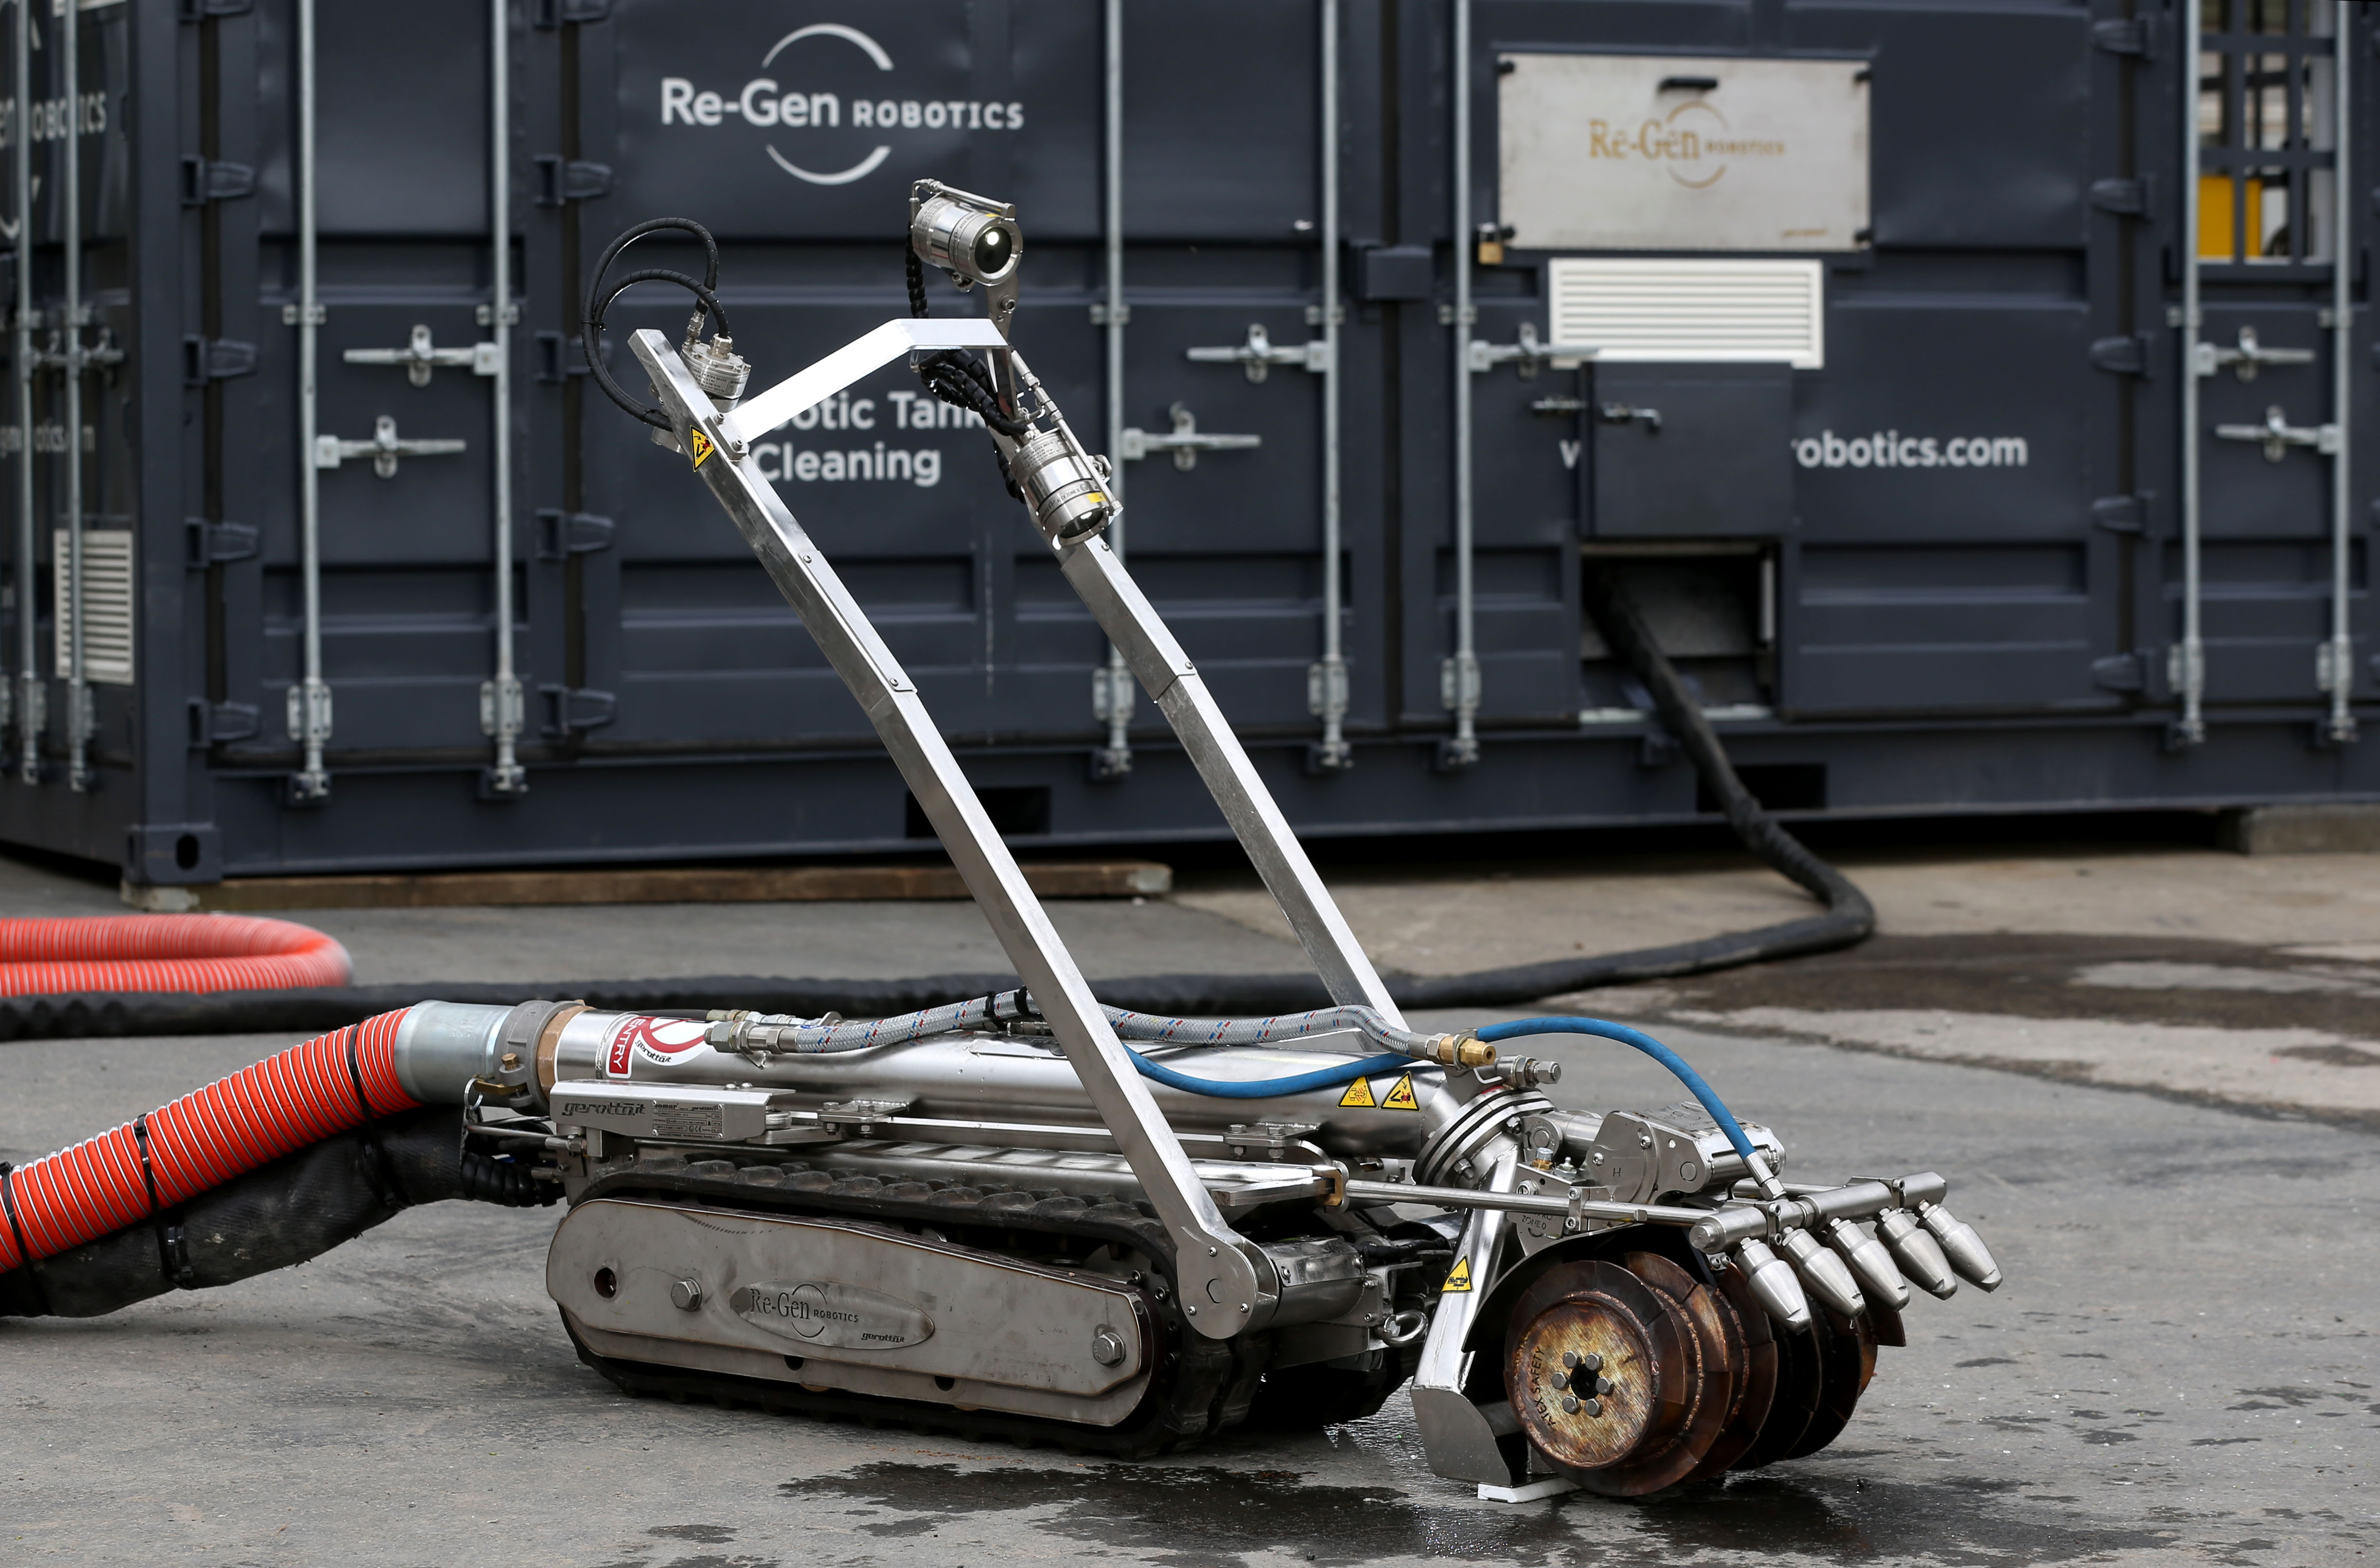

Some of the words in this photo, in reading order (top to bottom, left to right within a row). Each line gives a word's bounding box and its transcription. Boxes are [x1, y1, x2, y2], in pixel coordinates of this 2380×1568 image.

[662, 78, 839, 127] Re-Gen
[853, 99, 1024, 130] ROBOTICS
[1589, 119, 1700, 160] Re-Gen
[772, 391, 876, 431] otic
[752, 441, 941, 487] Cleaning
[1790, 428, 2028, 468] obotics.com
[613, 1018, 646, 1069] ENTRY
[1521, 1215, 1541, 1228] ZONE
[751, 1288, 810, 1319] Re-Gen
[814, 1309, 859, 1323] ROBOTICS
[1531, 1346, 1545, 1394] SAFETY
[1534, 1396, 1557, 1426] ATEX
